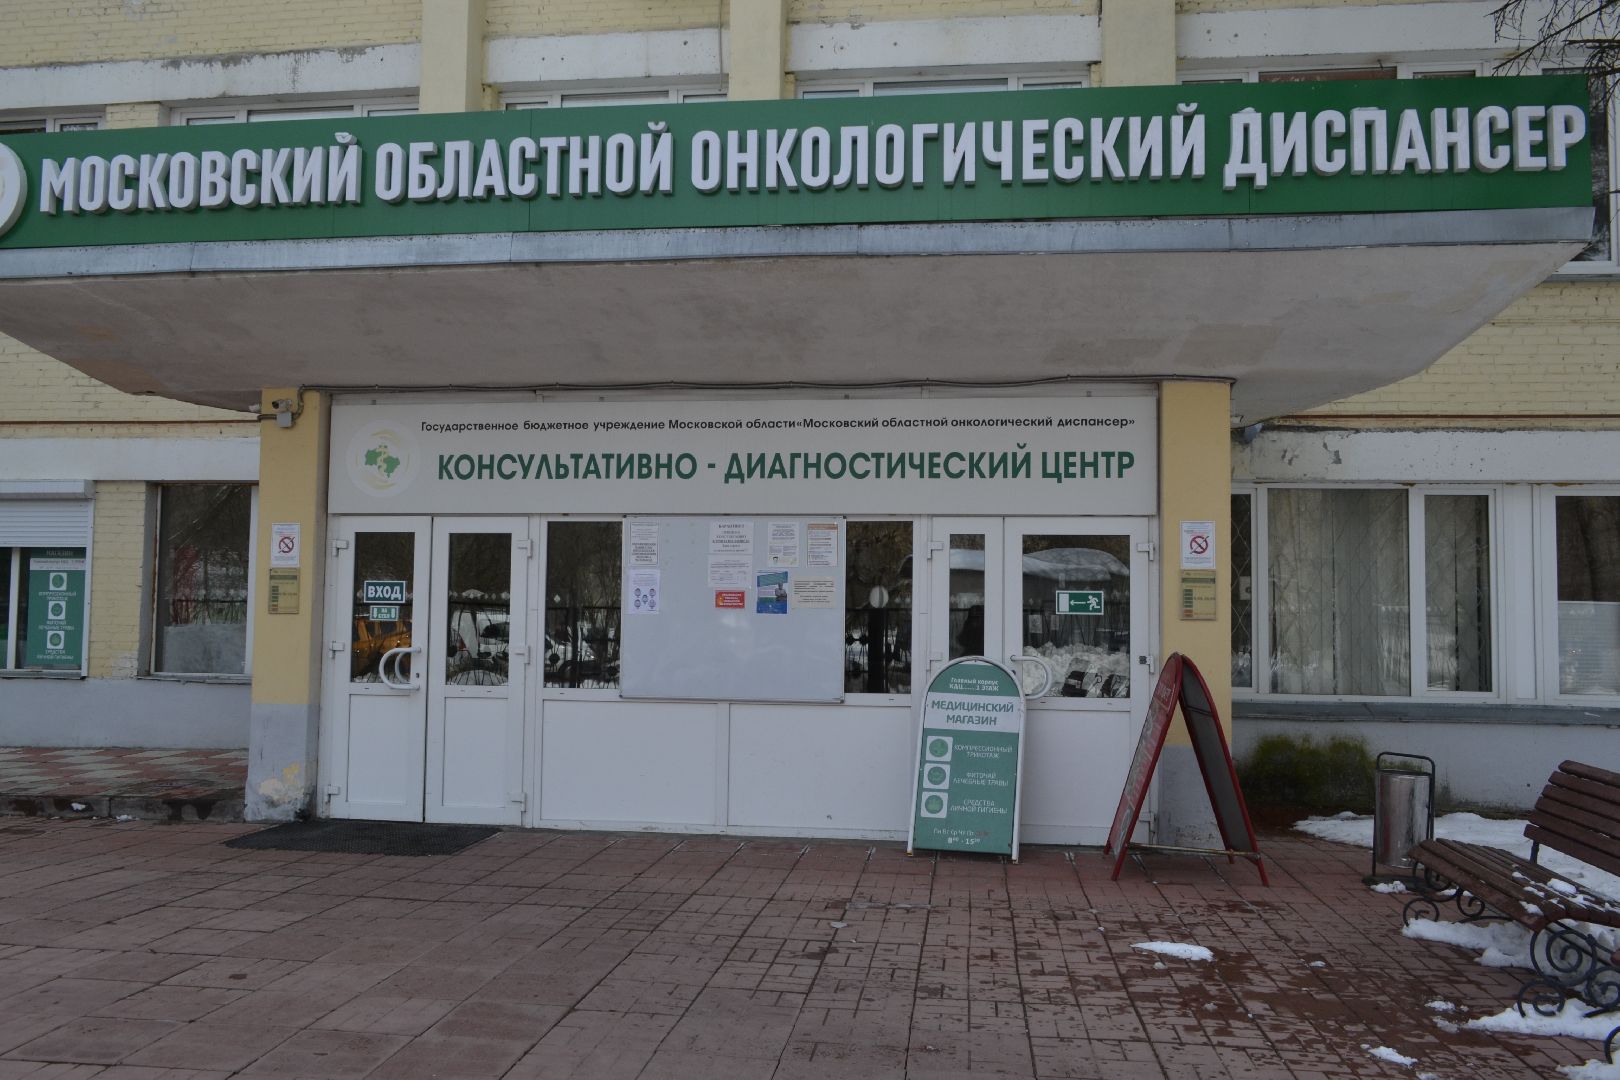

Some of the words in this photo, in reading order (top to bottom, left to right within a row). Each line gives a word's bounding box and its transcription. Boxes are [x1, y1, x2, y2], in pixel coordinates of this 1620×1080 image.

[39, 131, 362, 216] МОСКОВСКИЙ
[374, 121, 673, 202] ОБЛАСТНОЙ
[690, 103, 1206, 196] ОНКОЛОГИЧЕСКИЙ
[1222, 104, 1587, 192] ДИСПАНСЕР
[421, 420, 519, 433] Государственное
[523, 419, 589, 432] бюджетное
[593, 420, 666, 432] учреждение
[668, 418, 743, 430] Московской
[881, 416, 948, 428] областной
[950, 416, 1053, 428] онкологический
[1056, 417, 1135, 430] диспансер»
[438, 452, 698, 481] КОНСУЛЬТАТИВНО
[723, 442, 1032, 485] ДИАГНОСТИЧЕСКИЙ
[1041, 450, 1135, 485] ЦЕНТР
[367, 585, 402, 600] ВХОД
[931, 700, 1014, 713] МЕДИЦИНСКИЙ
[946, 714, 997, 726] МАГАЗИН
